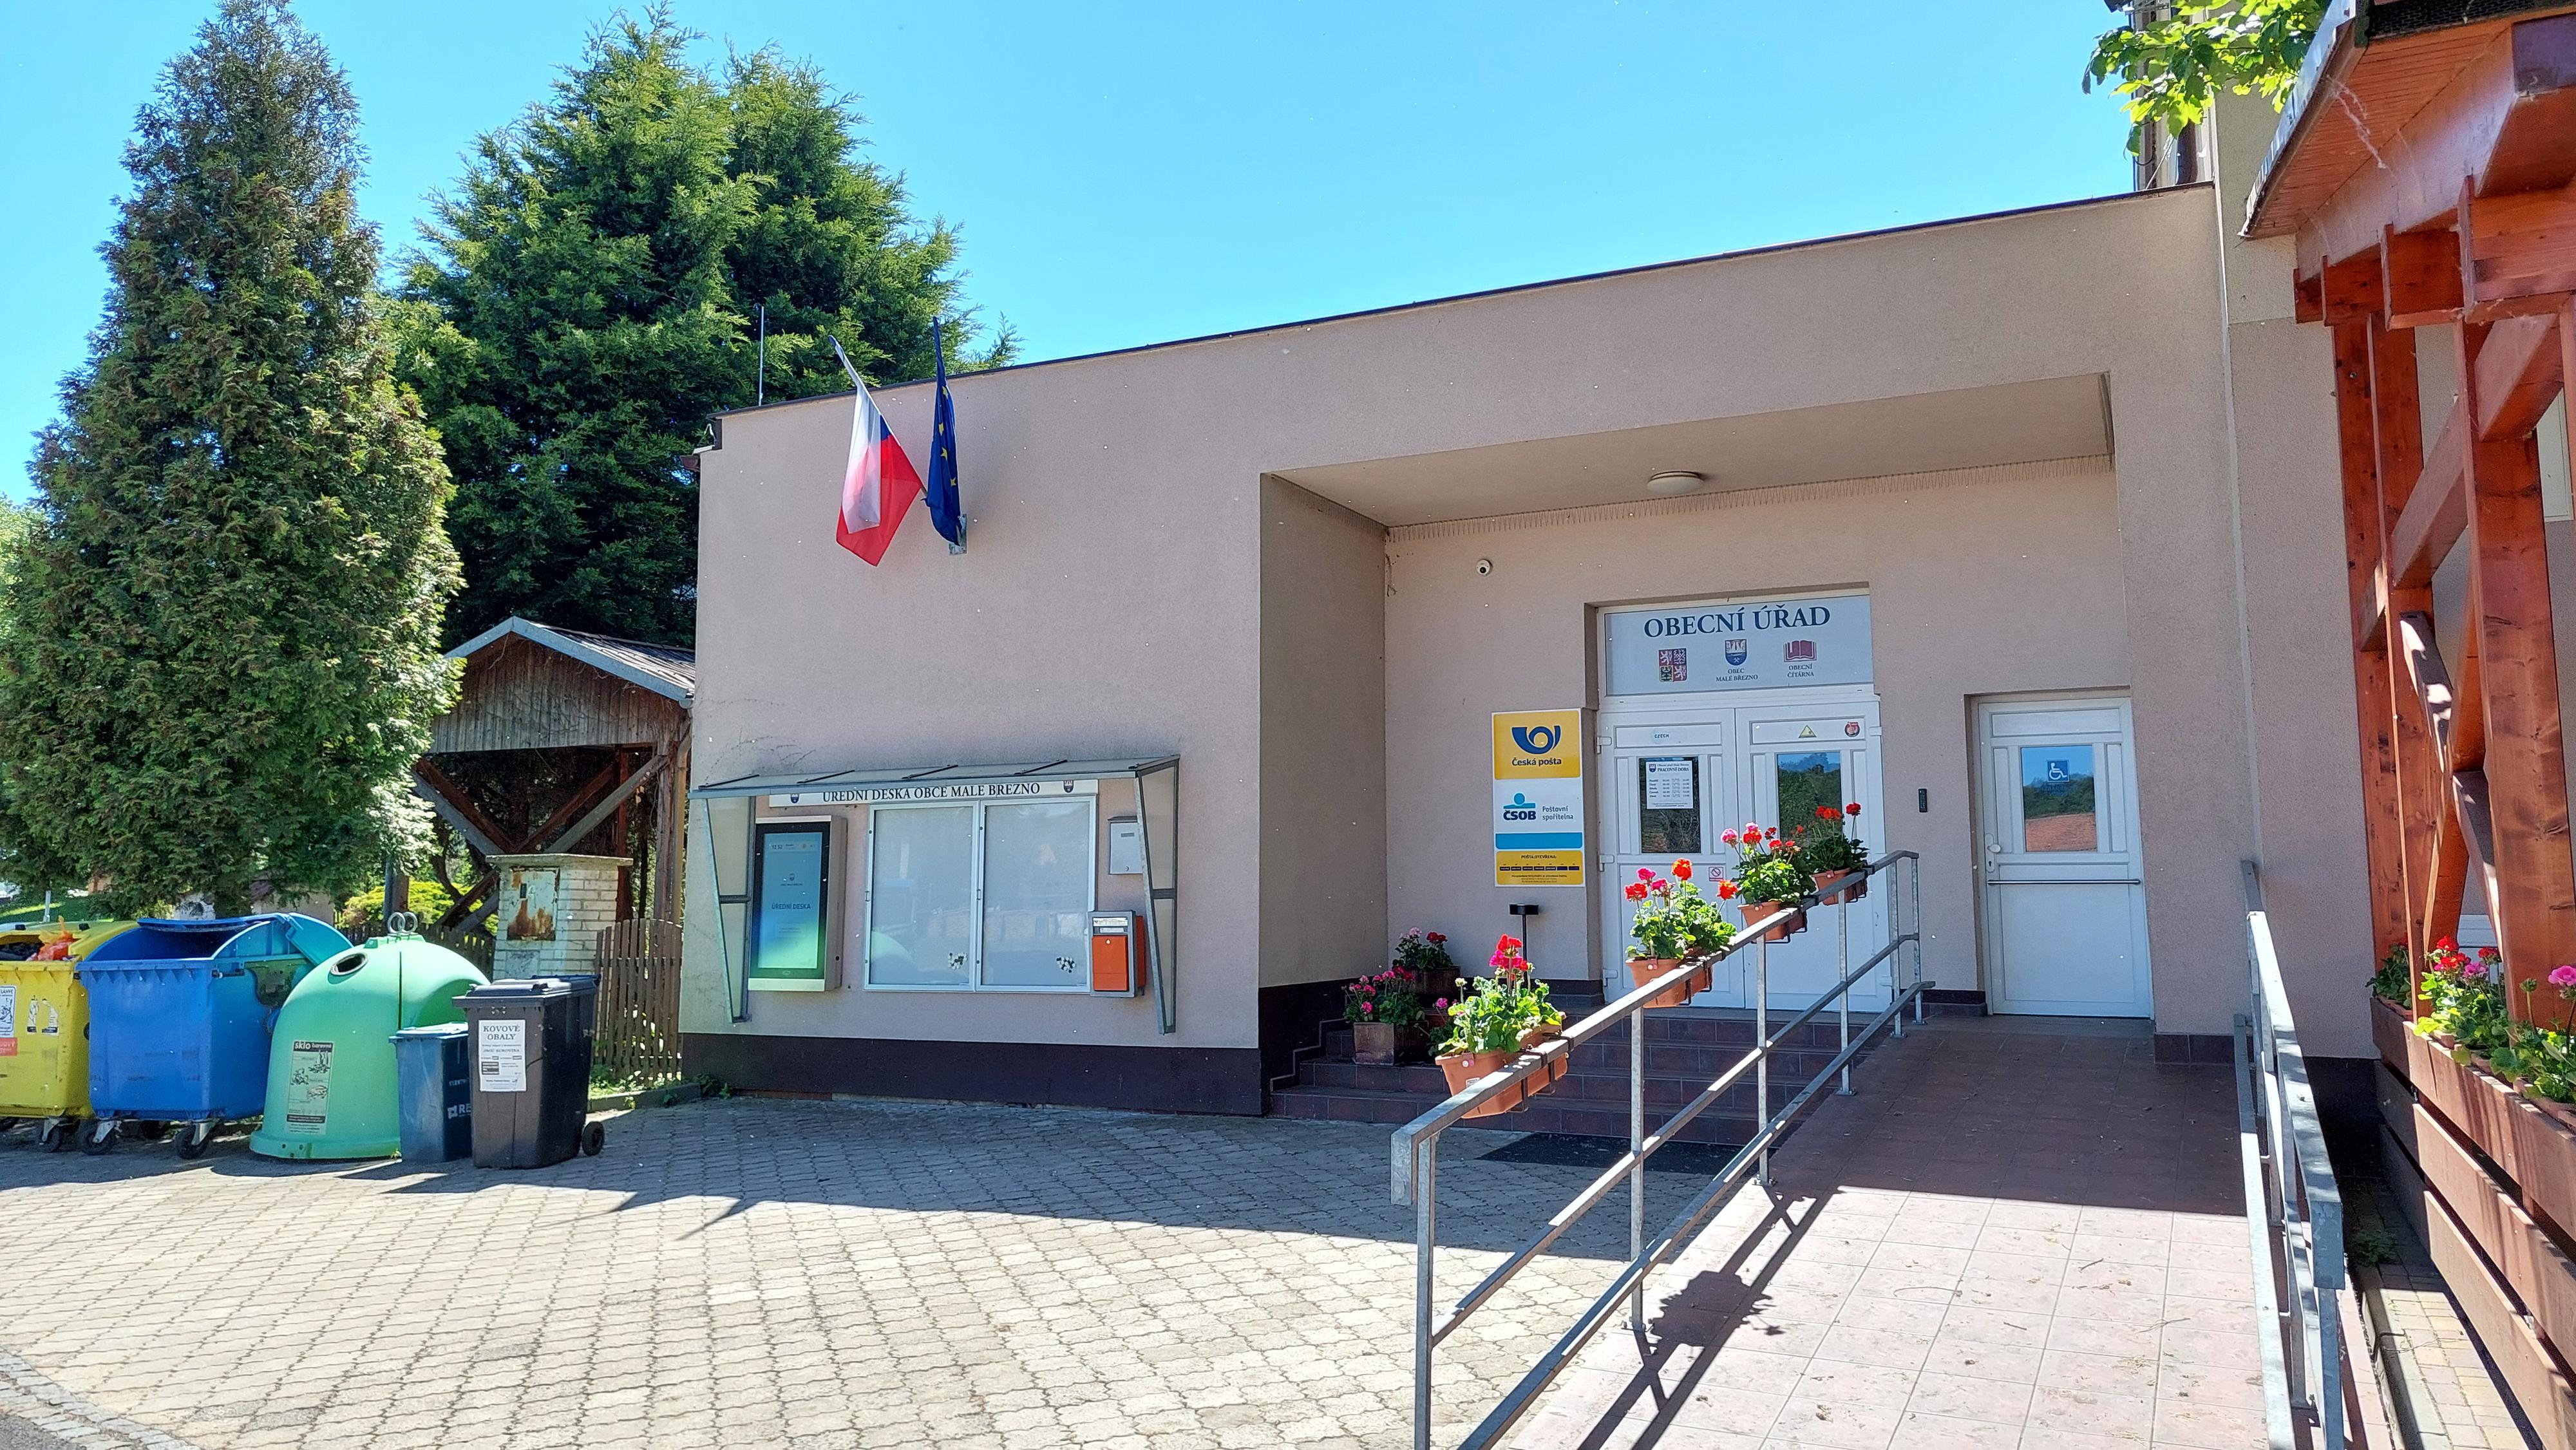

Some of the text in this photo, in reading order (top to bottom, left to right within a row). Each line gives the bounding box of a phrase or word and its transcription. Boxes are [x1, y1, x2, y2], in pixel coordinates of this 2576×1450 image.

[1644, 604, 1830, 637] OBECNÍ ÚŘAD
[1511, 757, 1562, 767] Česká pošta
[872, 787, 911, 800] DESKA
[914, 786, 948, 799] OBCE
[1502, 809, 1537, 821] ČSOB
[1542, 813, 1574, 822] spořitelna
[294, 1041, 311, 1050] sklo
